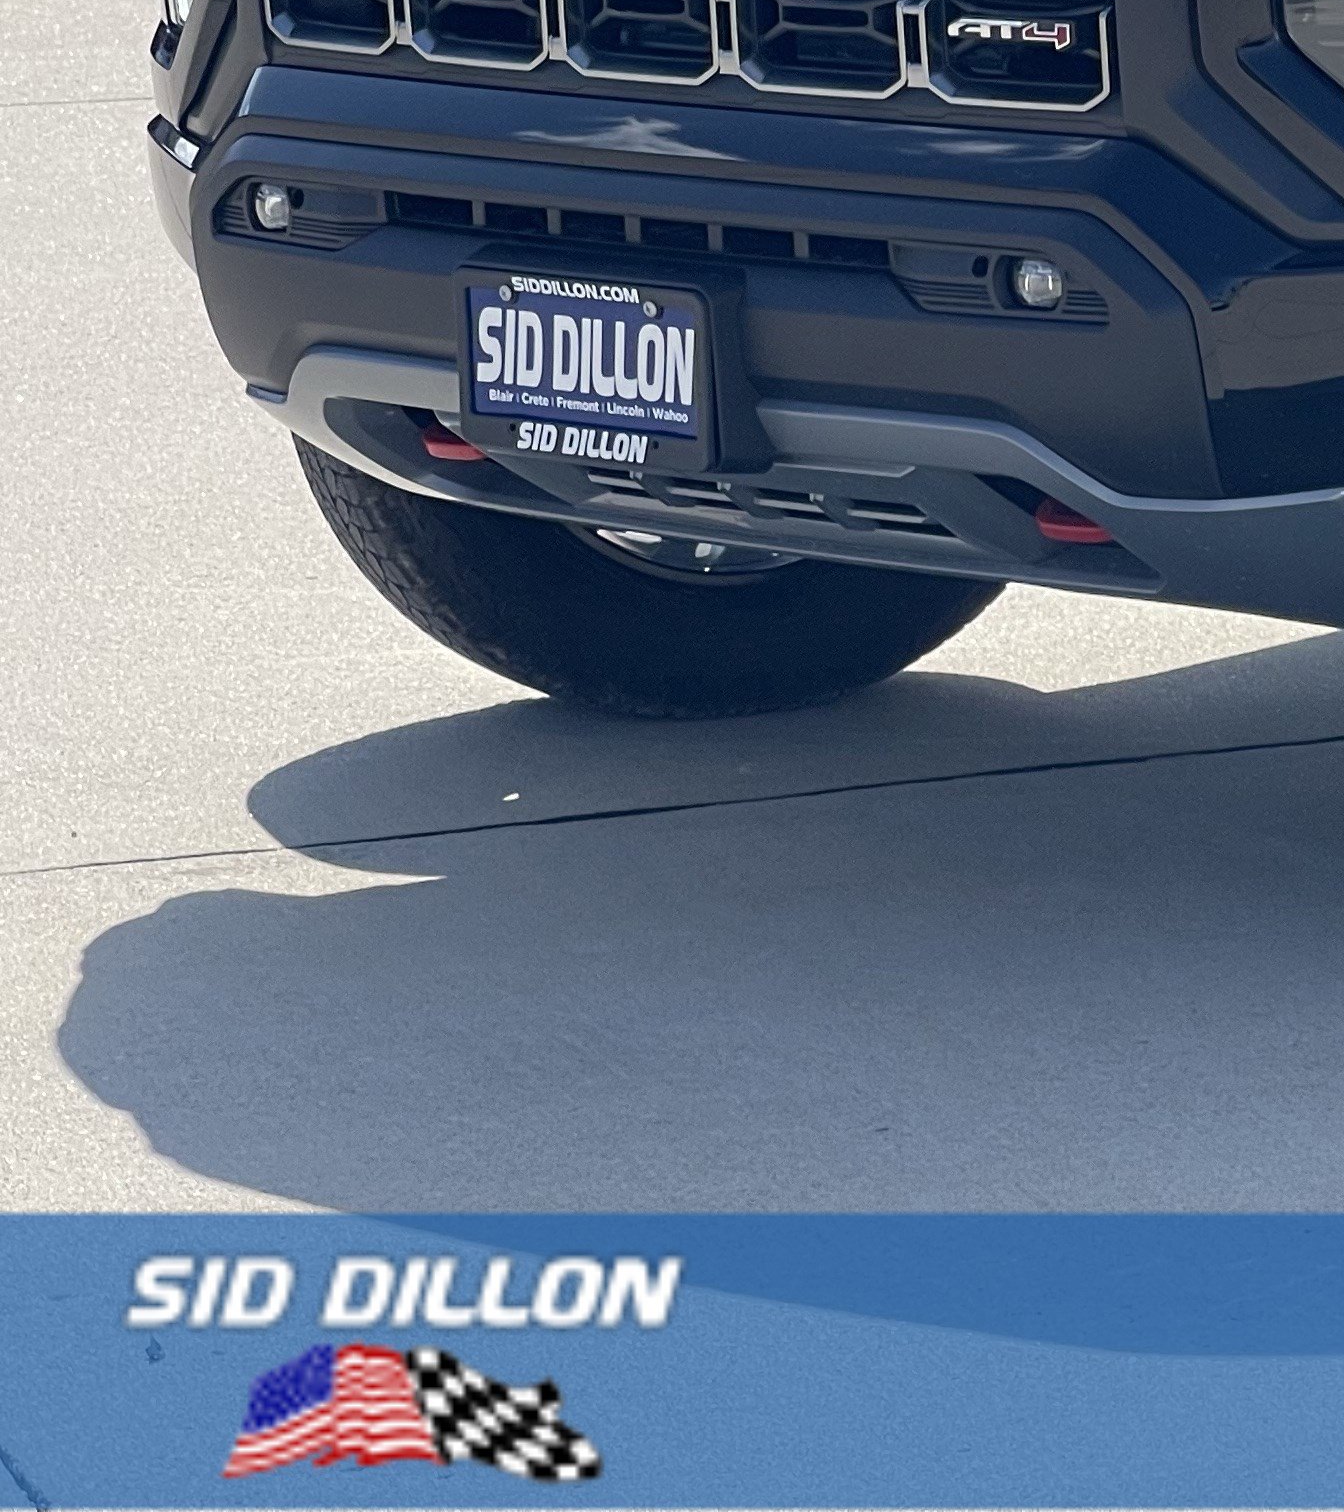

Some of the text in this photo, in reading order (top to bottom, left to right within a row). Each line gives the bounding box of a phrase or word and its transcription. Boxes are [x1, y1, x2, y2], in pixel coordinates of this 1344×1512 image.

[947, 17, 1070, 50] AT4
[510, 276, 640, 304] SIDDILLON.COM
[476, 306, 695, 405] SID DILLON
[489, 388, 689, 424] Blair Crete Fremont Lincoln Wahoo
[516, 421, 648, 464] SID DILLON
